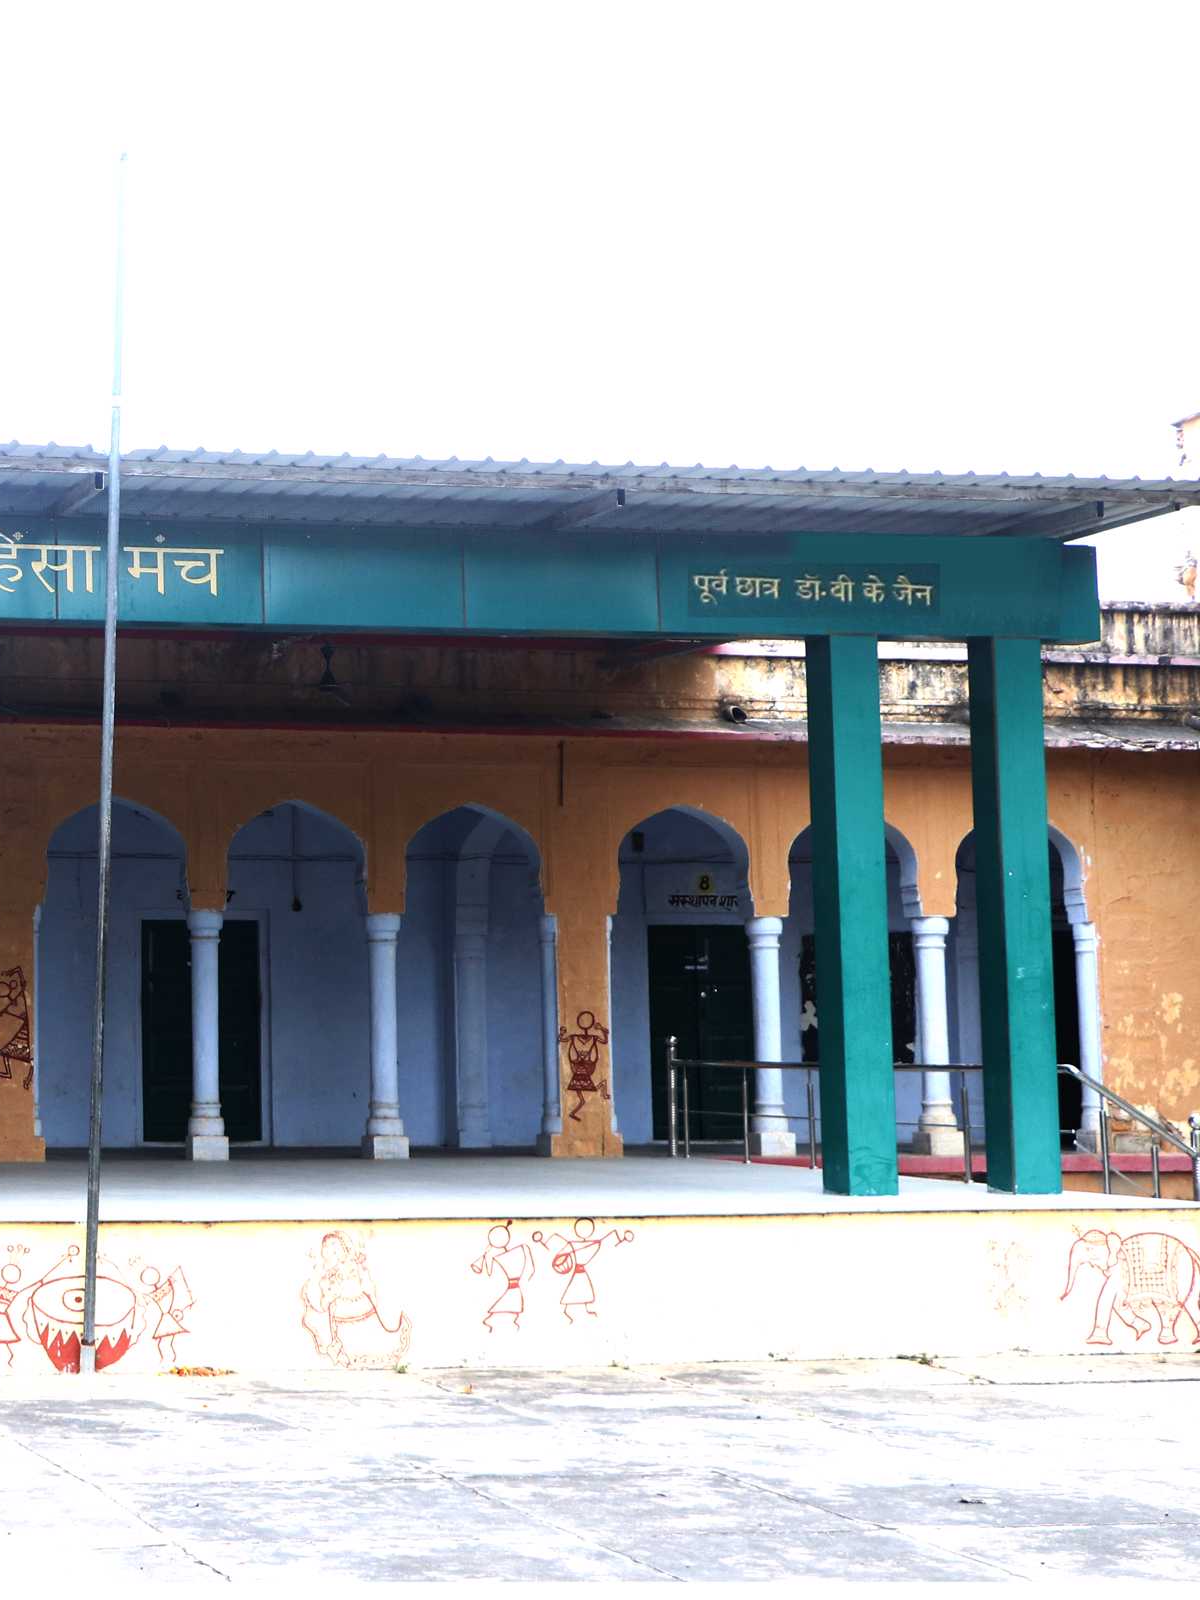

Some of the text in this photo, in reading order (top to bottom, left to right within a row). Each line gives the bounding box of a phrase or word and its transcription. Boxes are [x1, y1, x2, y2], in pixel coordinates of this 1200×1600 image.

[123, 533, 224, 597] मंच
[692, 569, 729, 605] पूर्व
[735, 576, 781, 599] छात्र
[862, 575, 885, 602] के
[891, 575, 934, 606] जैन
[699, 875, 710, 891] 8
